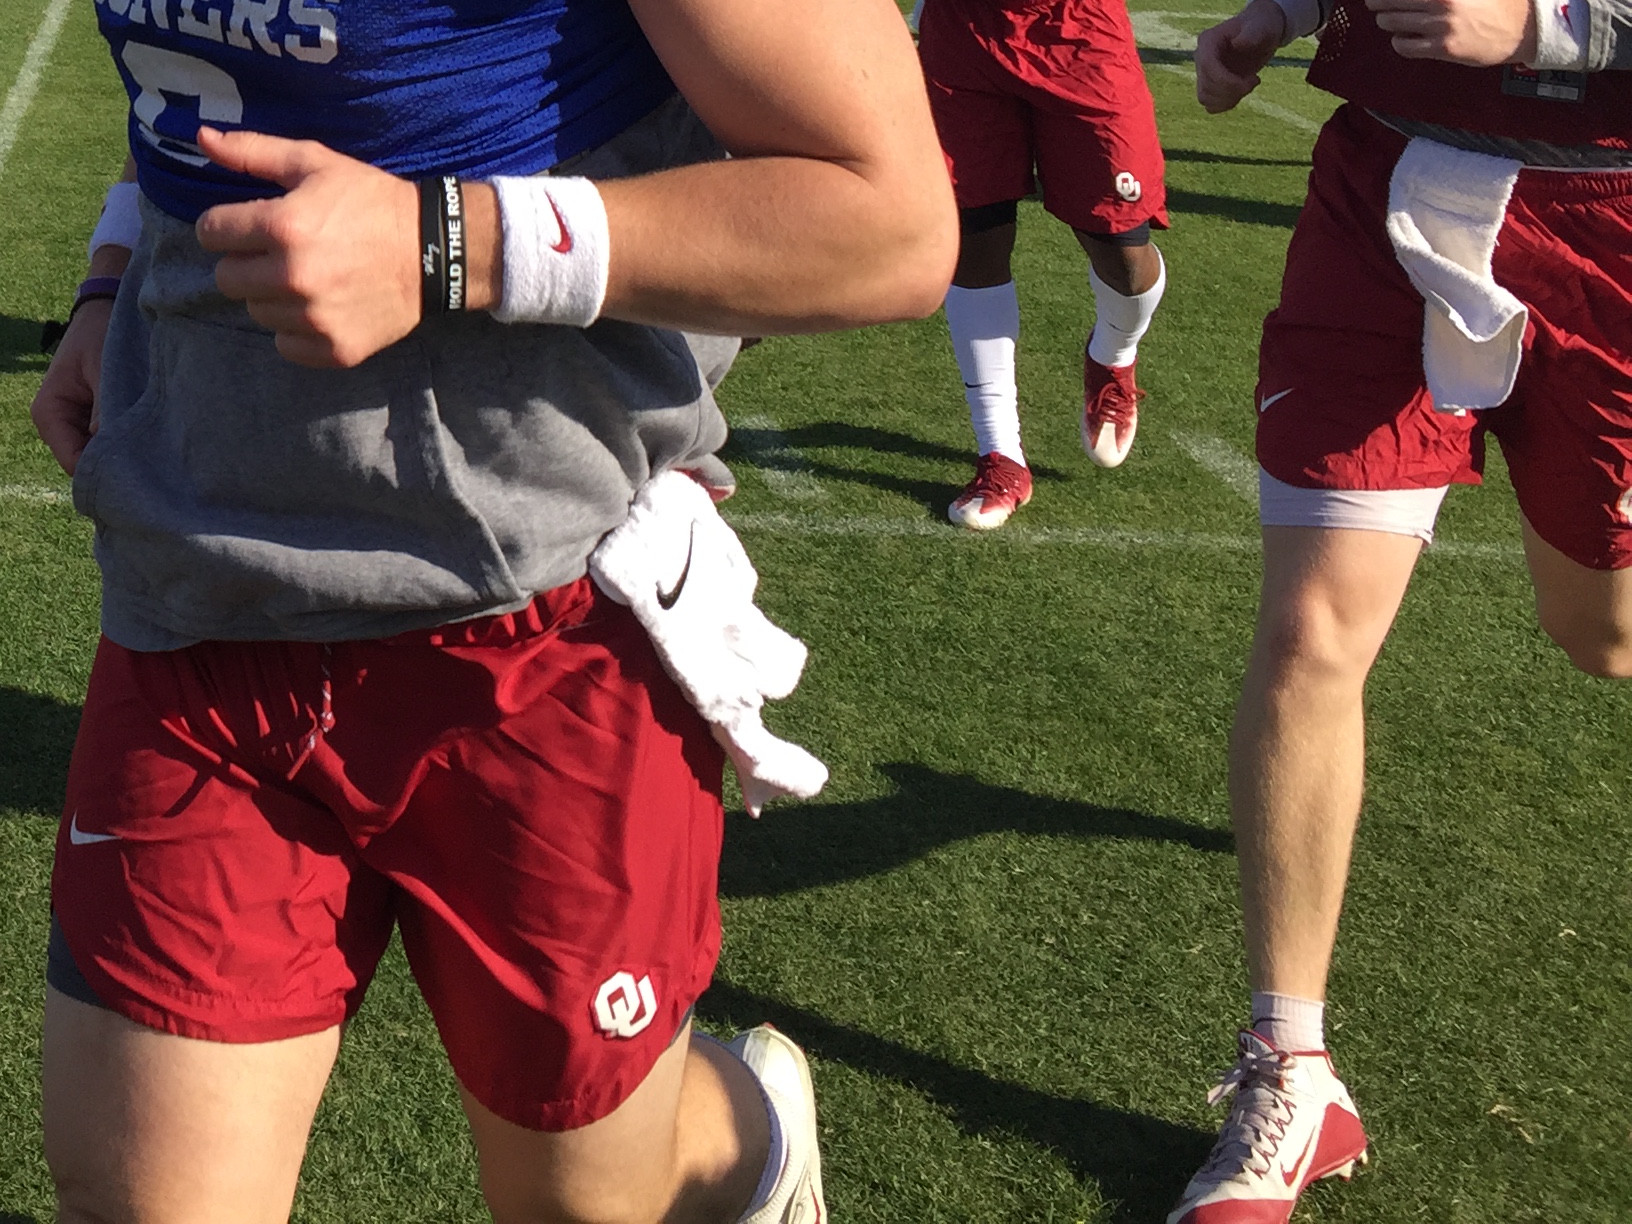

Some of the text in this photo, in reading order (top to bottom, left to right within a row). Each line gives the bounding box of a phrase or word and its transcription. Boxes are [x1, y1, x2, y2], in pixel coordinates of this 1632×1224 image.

[442, 176, 463, 310] HOLD THE ROPE
